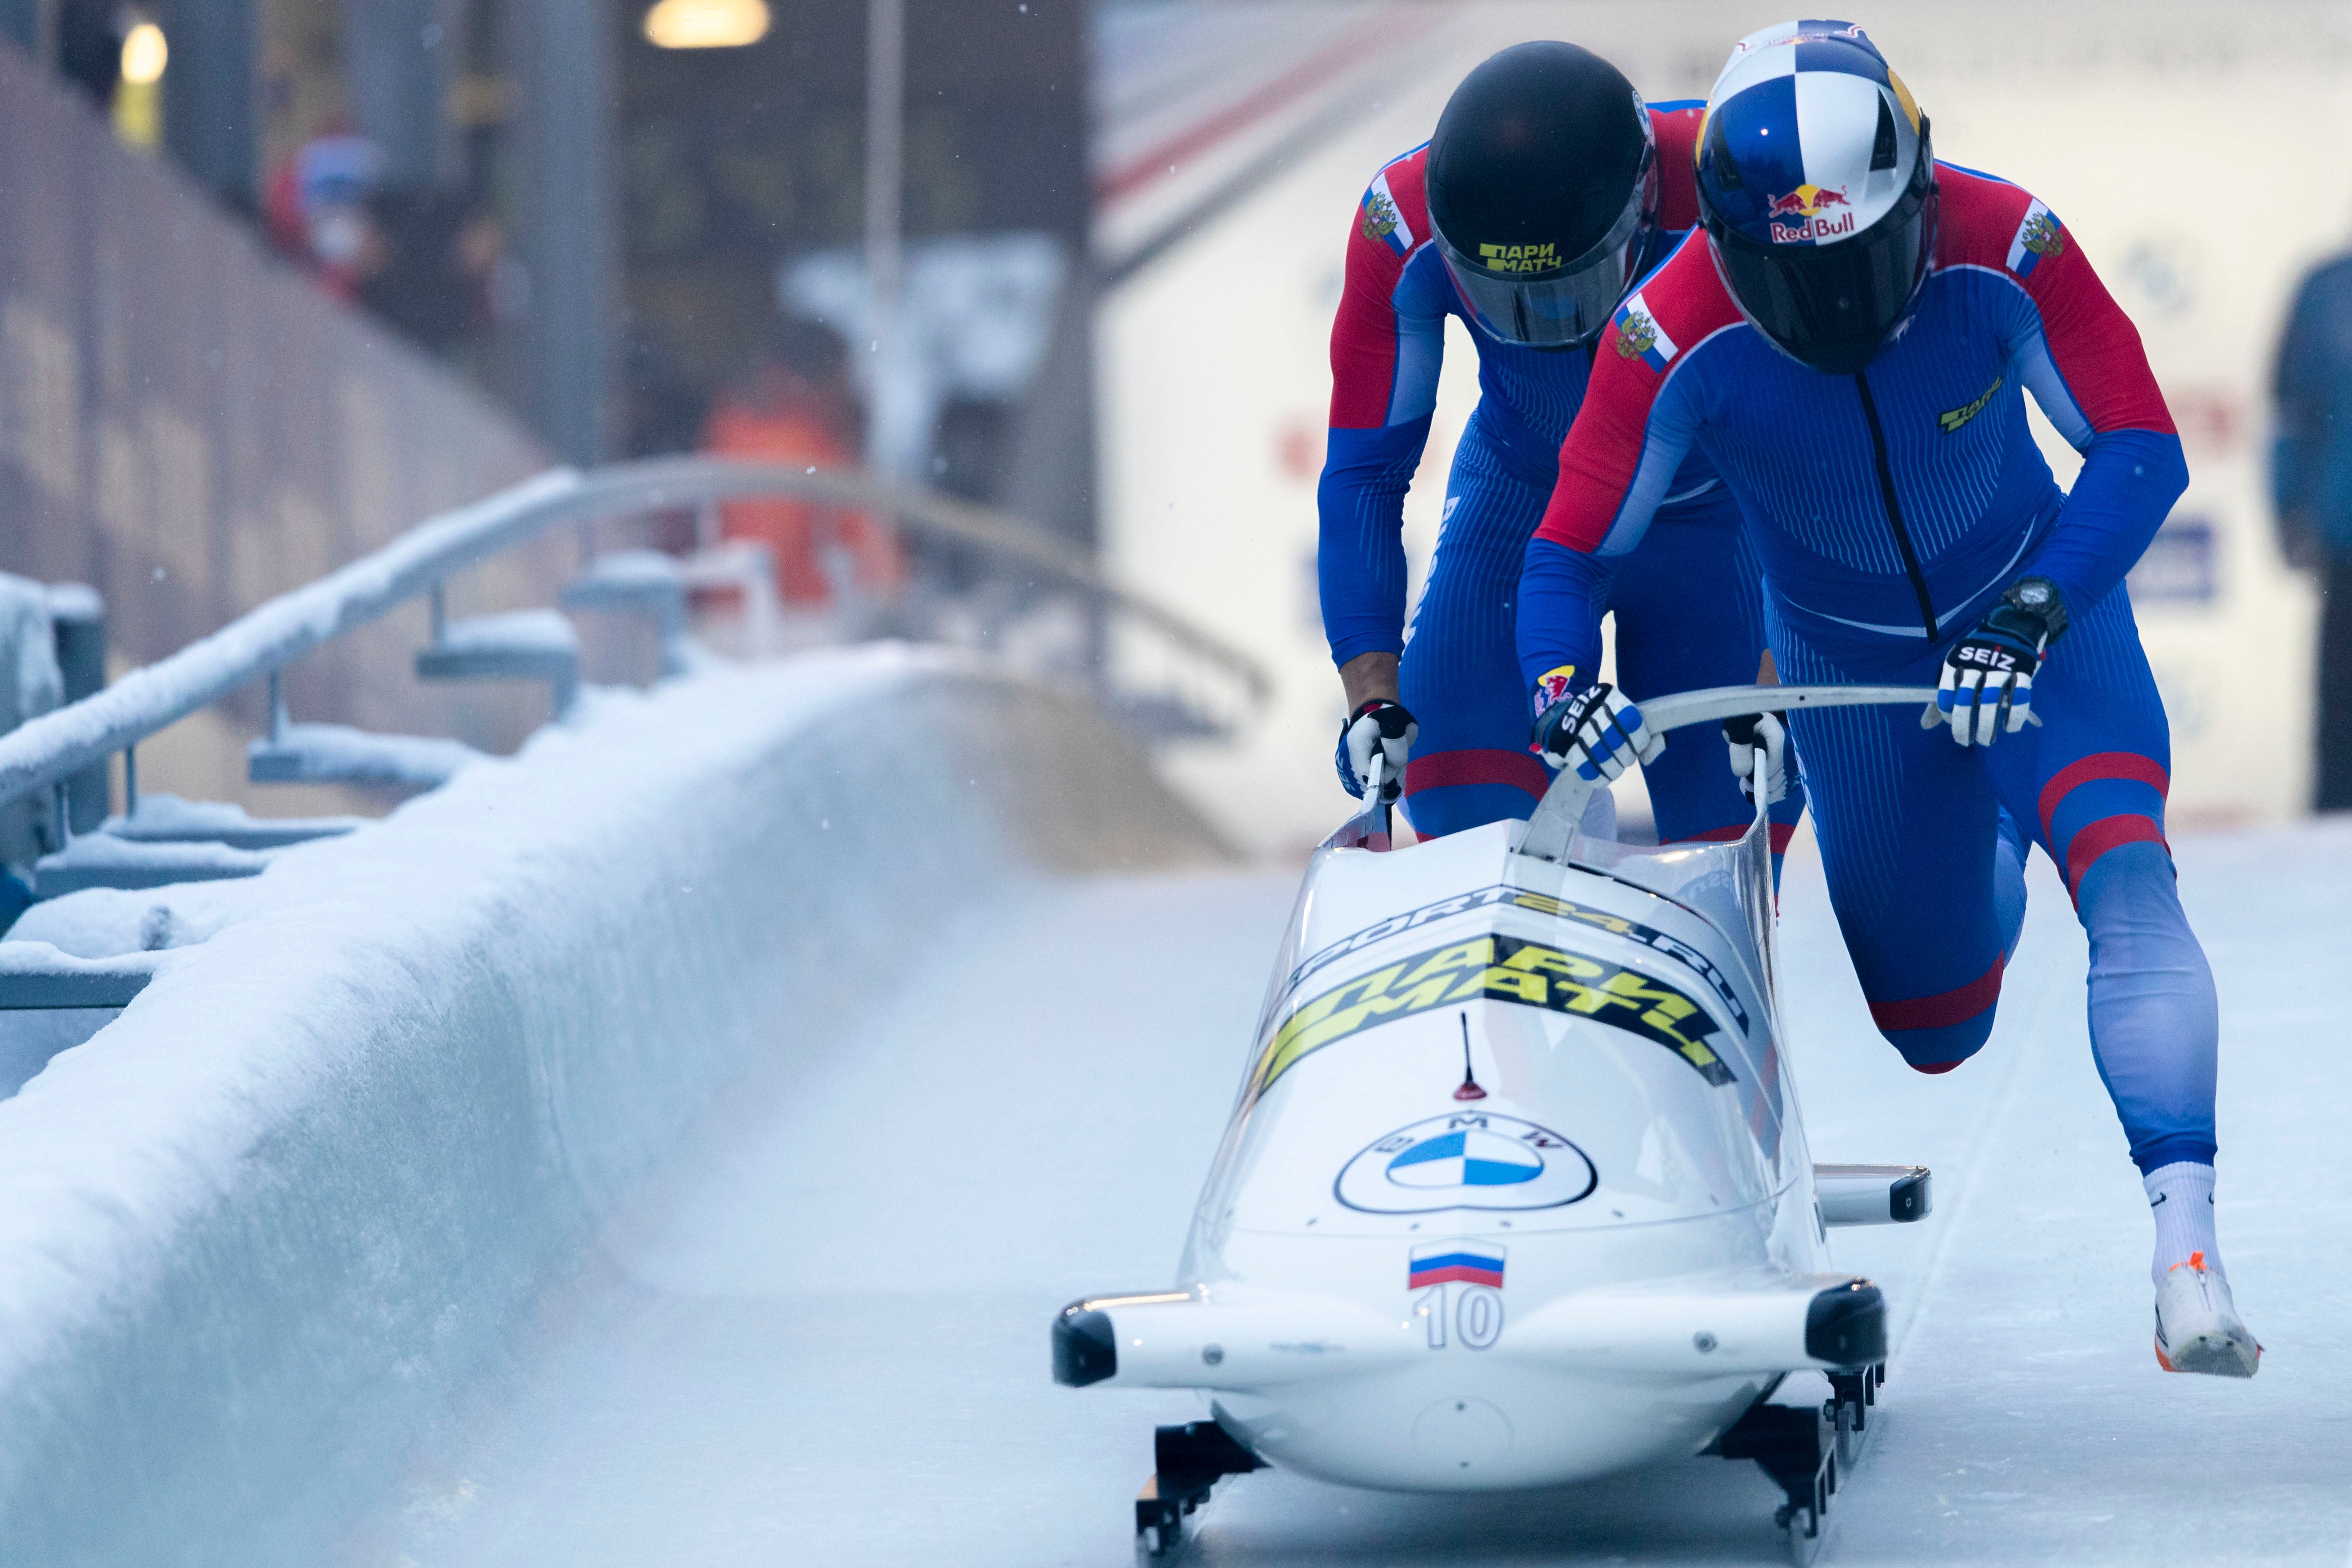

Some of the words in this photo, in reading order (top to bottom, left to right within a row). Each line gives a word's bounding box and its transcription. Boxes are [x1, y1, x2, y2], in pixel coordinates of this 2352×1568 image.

[1770, 217, 1814, 244] Red
[1815, 212, 1855, 237] Bull
[1479, 243, 1555, 260] ПАРИ
[1487, 256, 1562, 272] МАТЧ
[1958, 646, 2016, 671] SEIZ
[1252, 937, 1698, 1083] ПАРИ
[1260, 968, 1717, 1091] МАТЧ
[1413, 1284, 1505, 1350] 10
